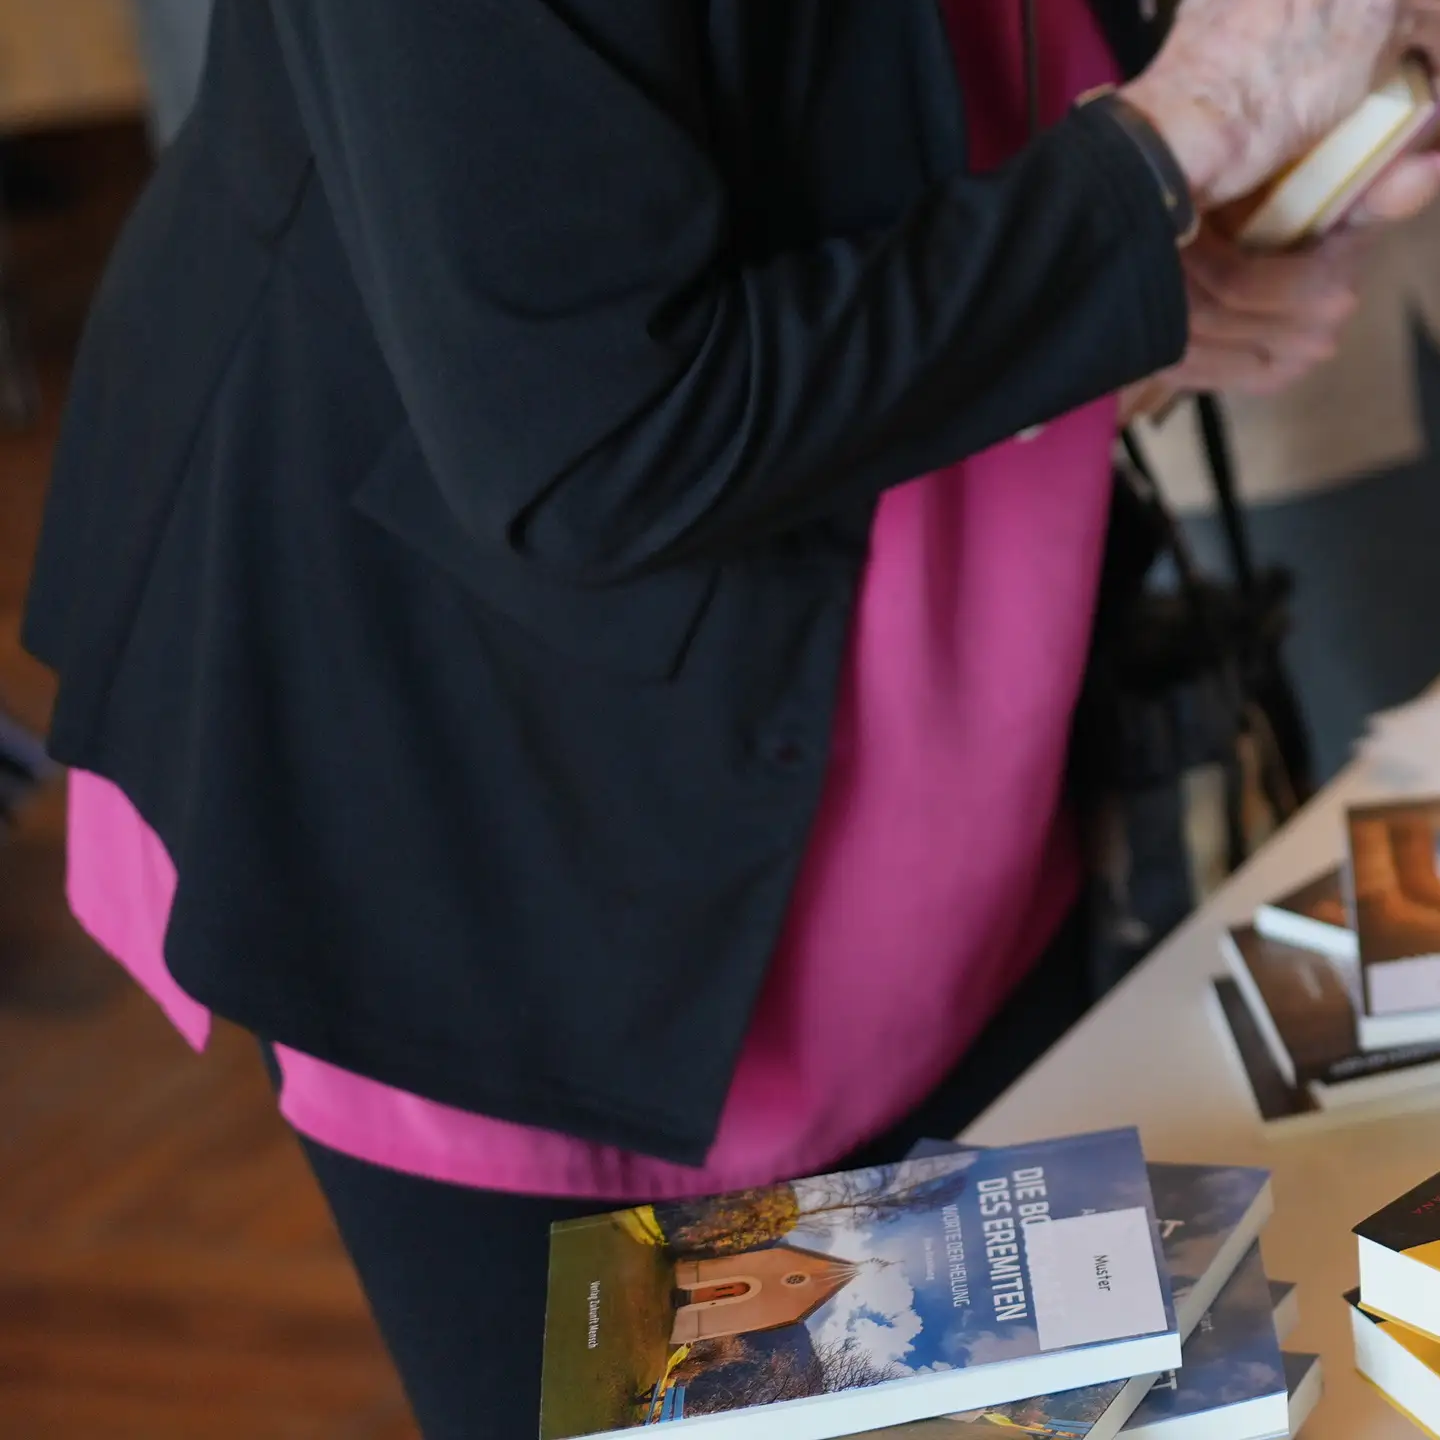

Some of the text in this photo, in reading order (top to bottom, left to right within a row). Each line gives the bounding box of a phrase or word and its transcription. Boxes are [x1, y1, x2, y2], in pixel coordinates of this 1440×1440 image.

[1012, 1166, 1047, 1200] DIE
[942, 1203, 971, 1308] WORTE DER HEILUNG
[976, 1177, 1028, 1322] DES EREMITEN
[1093, 1255, 1111, 1292] Muster
[589, 1300, 600, 1325] Zukunft
[588, 1324, 599, 1349] Mensch
